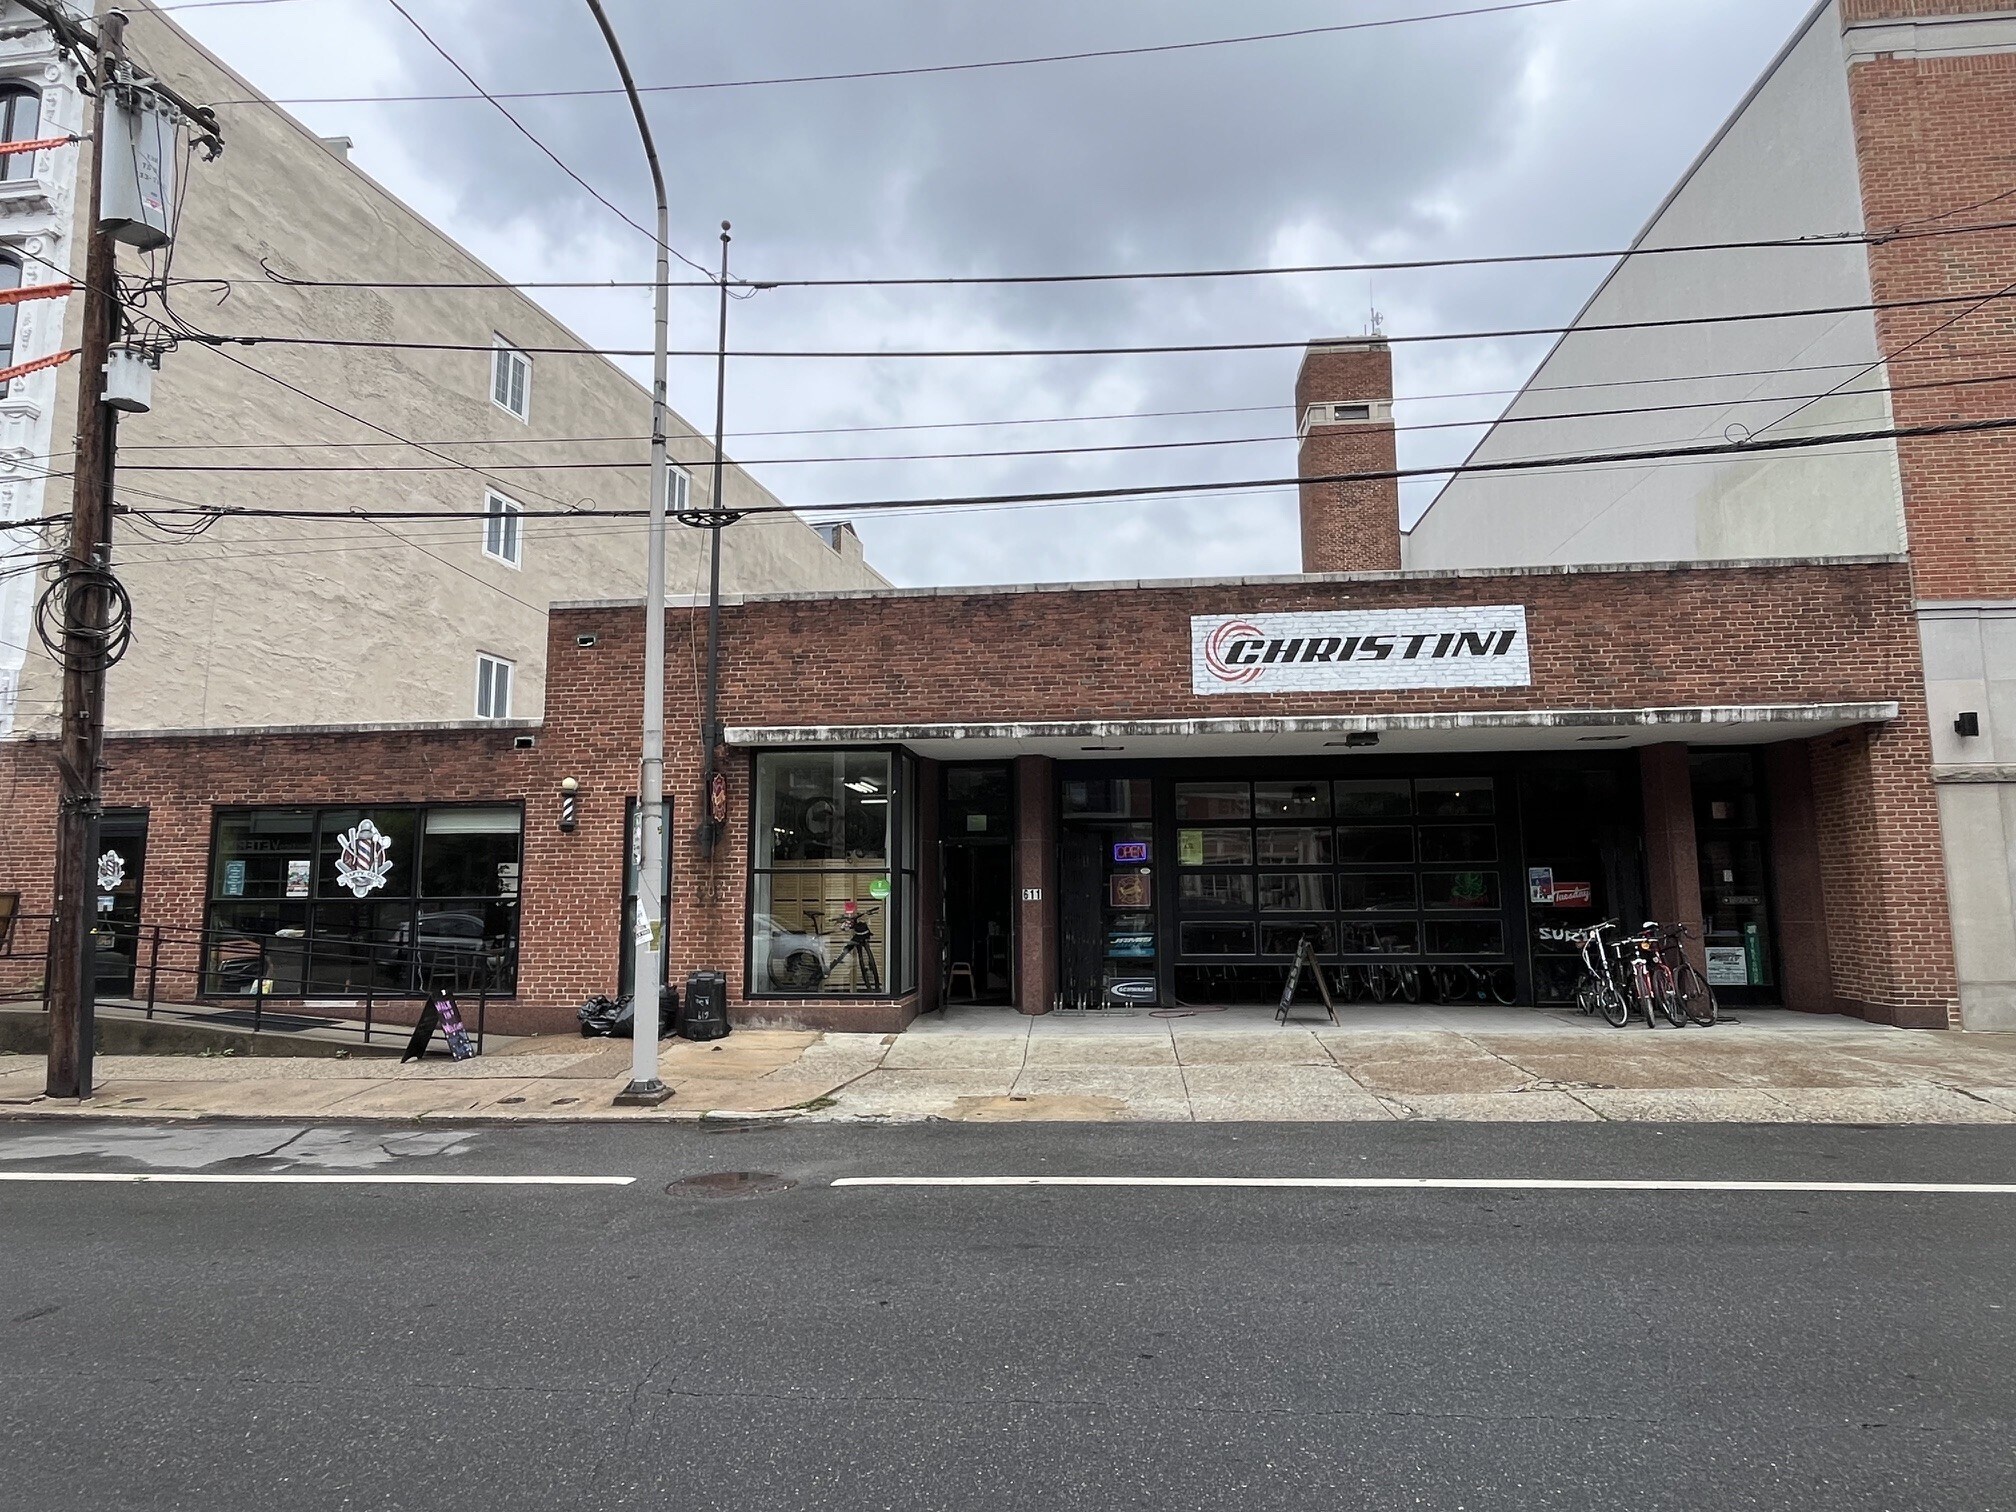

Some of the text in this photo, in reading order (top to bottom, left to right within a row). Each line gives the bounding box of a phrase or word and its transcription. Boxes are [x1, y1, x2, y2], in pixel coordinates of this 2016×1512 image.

[1224, 629, 1517, 665] CHRISTINI
[1117, 845, 1145, 858] OPEN
[1023, 889, 1040, 900] 611
